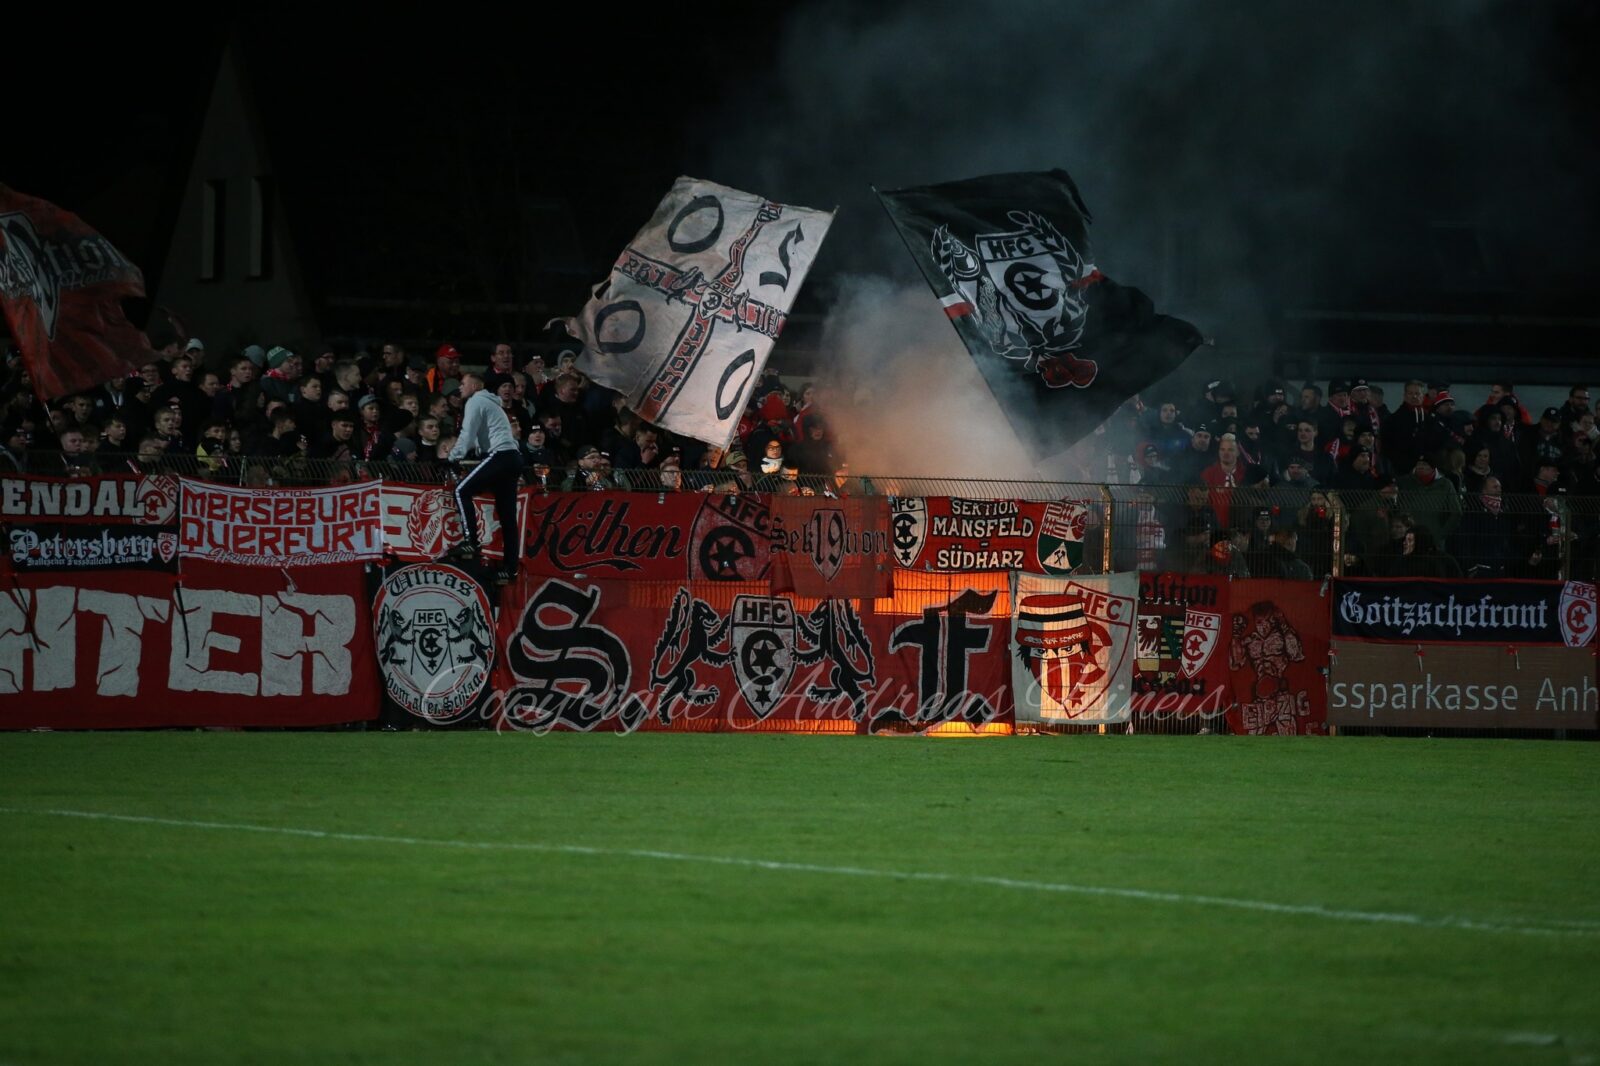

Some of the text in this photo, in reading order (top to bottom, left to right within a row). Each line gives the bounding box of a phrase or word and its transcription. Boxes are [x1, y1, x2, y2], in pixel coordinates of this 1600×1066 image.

[987, 237, 1034, 259] HFC
[0, 478, 146, 517] ENDAL
[154, 475, 178, 498] HFC
[252, 490, 312, 498] SEKTION
[182, 485, 381, 526] MERSEBURG
[719, 494, 769, 531] HFC
[951, 500, 1019, 516] SEKTION
[181, 517, 381, 557] QUERFURT
[526, 497, 683, 572] Köthen
[932, 516, 1035, 538] MANSFELD
[10, 528, 155, 563] Petersberg
[937, 544, 1024, 570] SÜDHARZ
[386, 567, 476, 597] Ultras
[417, 611, 444, 624] HFC
[742, 602, 787, 624] HFC
[1076, 589, 1123, 622] HFC
[1185, 613, 1213, 628] HFC
[1339, 590, 1549, 637] Goitzschefront
[1331, 673, 1519, 718] ssparkasse
